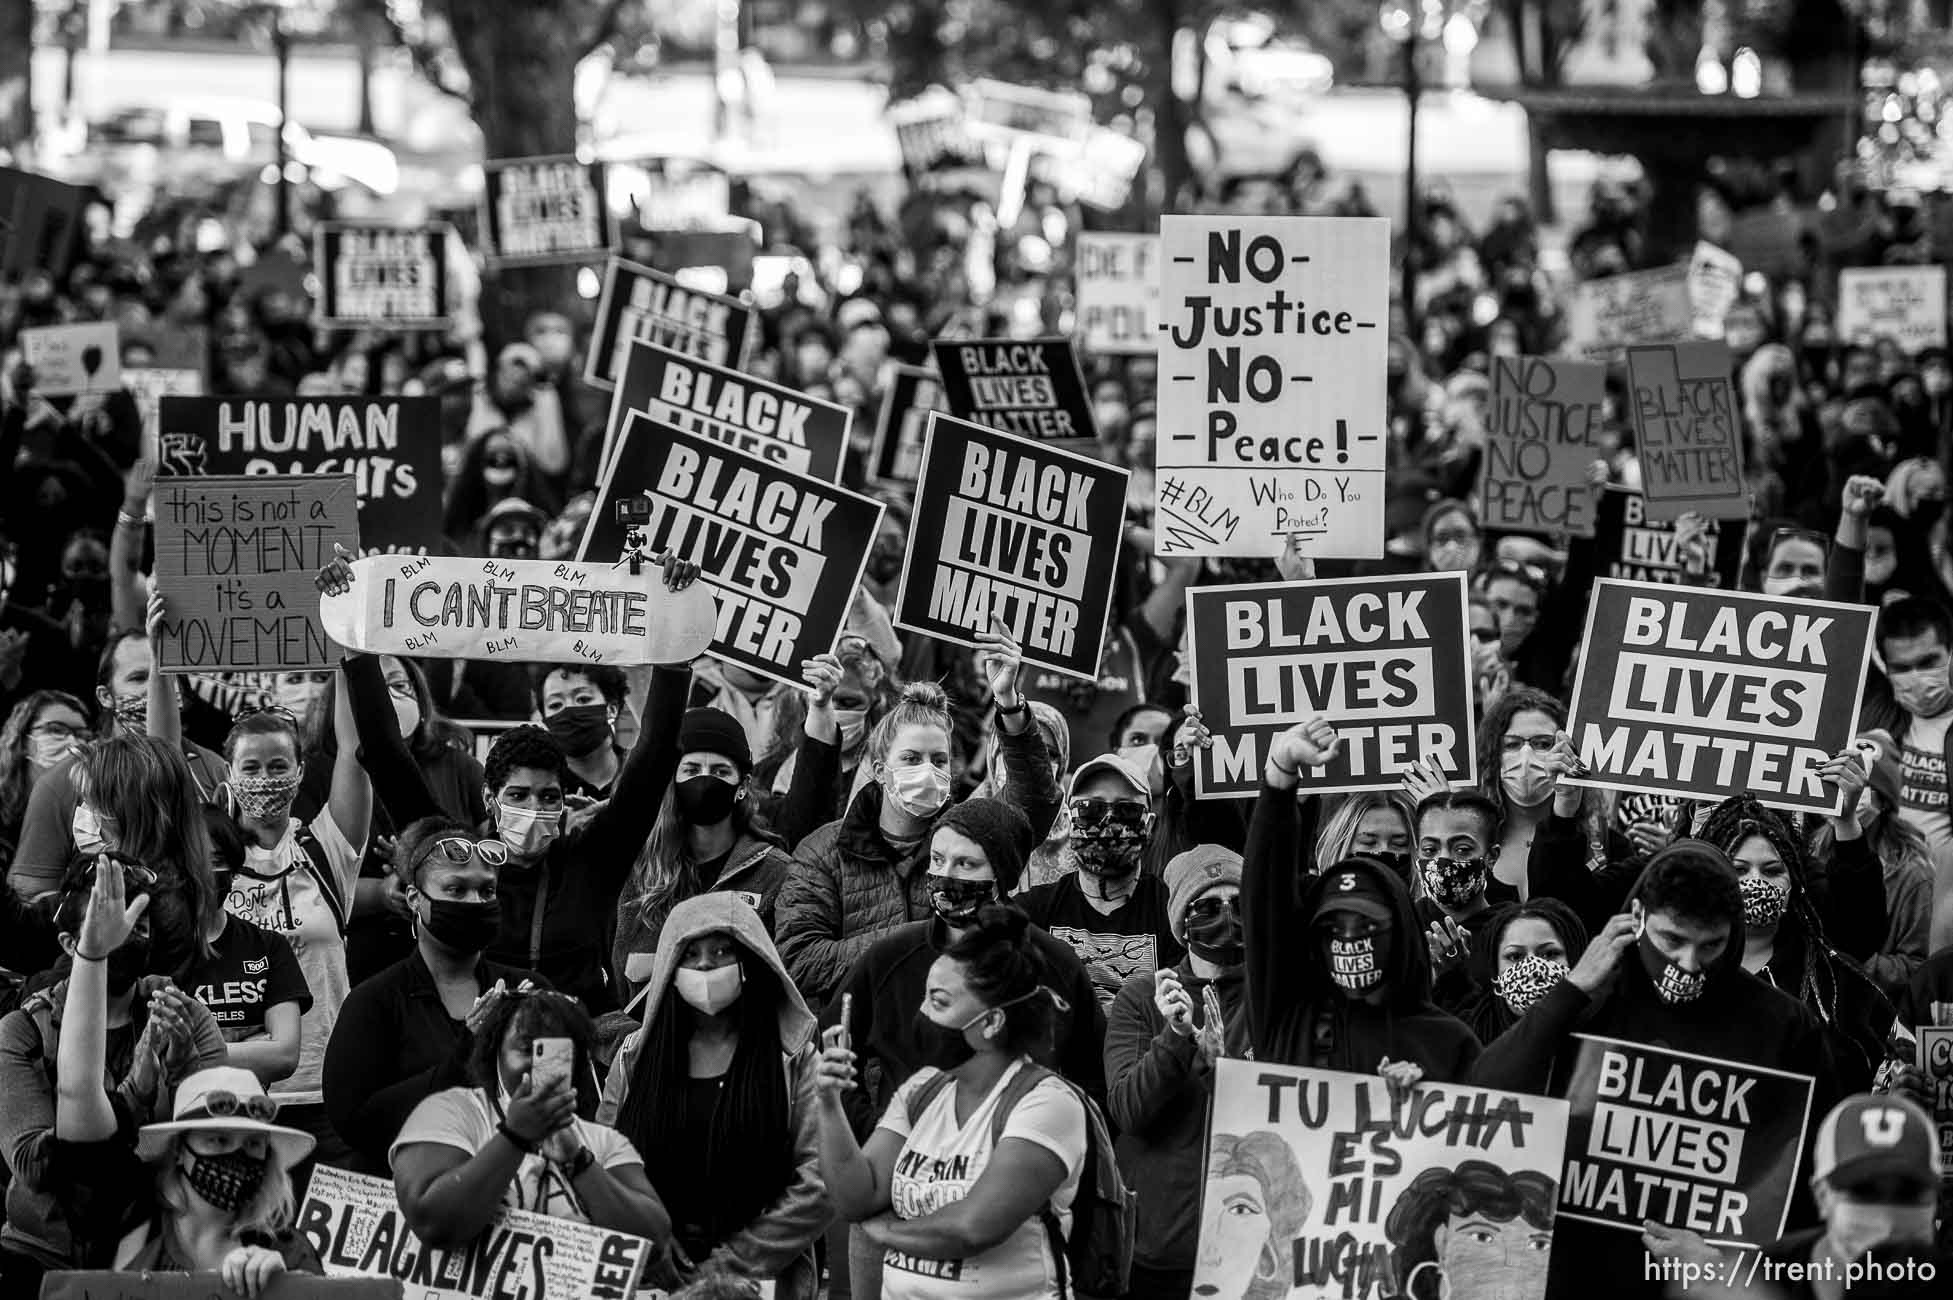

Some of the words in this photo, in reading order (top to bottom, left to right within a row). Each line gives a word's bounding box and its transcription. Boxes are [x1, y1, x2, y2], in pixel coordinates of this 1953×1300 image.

[960, 346, 1049, 375] BLACK
[1495, 356, 1556, 398] NO
[660, 361, 812, 447] BLACK
[974, 377, 1050, 406] LIVES
[1636, 382, 1729, 419] BLACK
[218, 401, 399, 453] HUMAN
[1486, 396, 1600, 447] JUSTICE
[1641, 416, 1728, 446] LIVES
[1488, 438, 1549, 480] NO
[1643, 447, 1739, 484] MATTER
[165, 488, 223, 523] this
[231, 493, 255, 523] is
[262, 488, 301, 521] not
[309, 499, 328, 520] a
[657, 442, 838, 551] BLACK
[959, 440, 1096, 531] BLACK
[1160, 477, 1240, 541] #BLM
[1249, 477, 1294, 506] Who
[1305, 478, 1328, 501] Do
[1335, 477, 1361, 503] You
[1484, 478, 1586, 530] PEACE
[1276, 507, 1329, 530] Protect?
[183, 525, 337, 577] MOMENT
[401, 557, 431, 580] BLM
[482, 560, 515, 582] BLM
[650, 502, 800, 600] LIVES
[957, 506, 1073, 590] LIVES
[217, 581, 253, 614] it's
[266, 590, 286, 611] a
[554, 563, 587, 586] BLM
[383, 578, 396, 628] I
[519, 584, 648, 637] BREATE
[714, 588, 802, 668] TER
[928, 564, 1080, 657] MATTER
[1225, 590, 1431, 651] BLACK
[1623, 597, 1835, 666] BLACK
[158, 616, 329, 668] MOVEMEN
[405, 631, 438, 651] BLM
[486, 636, 519, 655] BLM
[572, 640, 604, 662] BLM
[1243, 658, 1418, 715] LIVES
[1626, 663, 1808, 728] LIVES
[1212, 723, 1458, 783] MTER
[1579, 723, 1835, 798] MATTER
[1900, 784, 1949, 805] ATTER
[1339, 873, 1356, 891] 3
[1331, 937, 1374, 954] BLACK
[1335, 955, 1373, 971] LIVES
[1257, 1073, 1329, 1129] TU
[1355, 1081, 1534, 1150] LUCHA
[1598, 1051, 1757, 1123] BLACK
[1601, 1110, 1730, 1174] LIVES
[1860, 1107, 1906, 1146] U
[1329, 1130, 1402, 1177] ES
[1324, 1177, 1382, 1225] MI
[1562, 1160, 1748, 1236] MATTER
[300, 1197, 433, 1287] BLACK
[433, 1224, 555, 1300] LIVES
[1293, 1231, 1402, 1300] LUCHA
